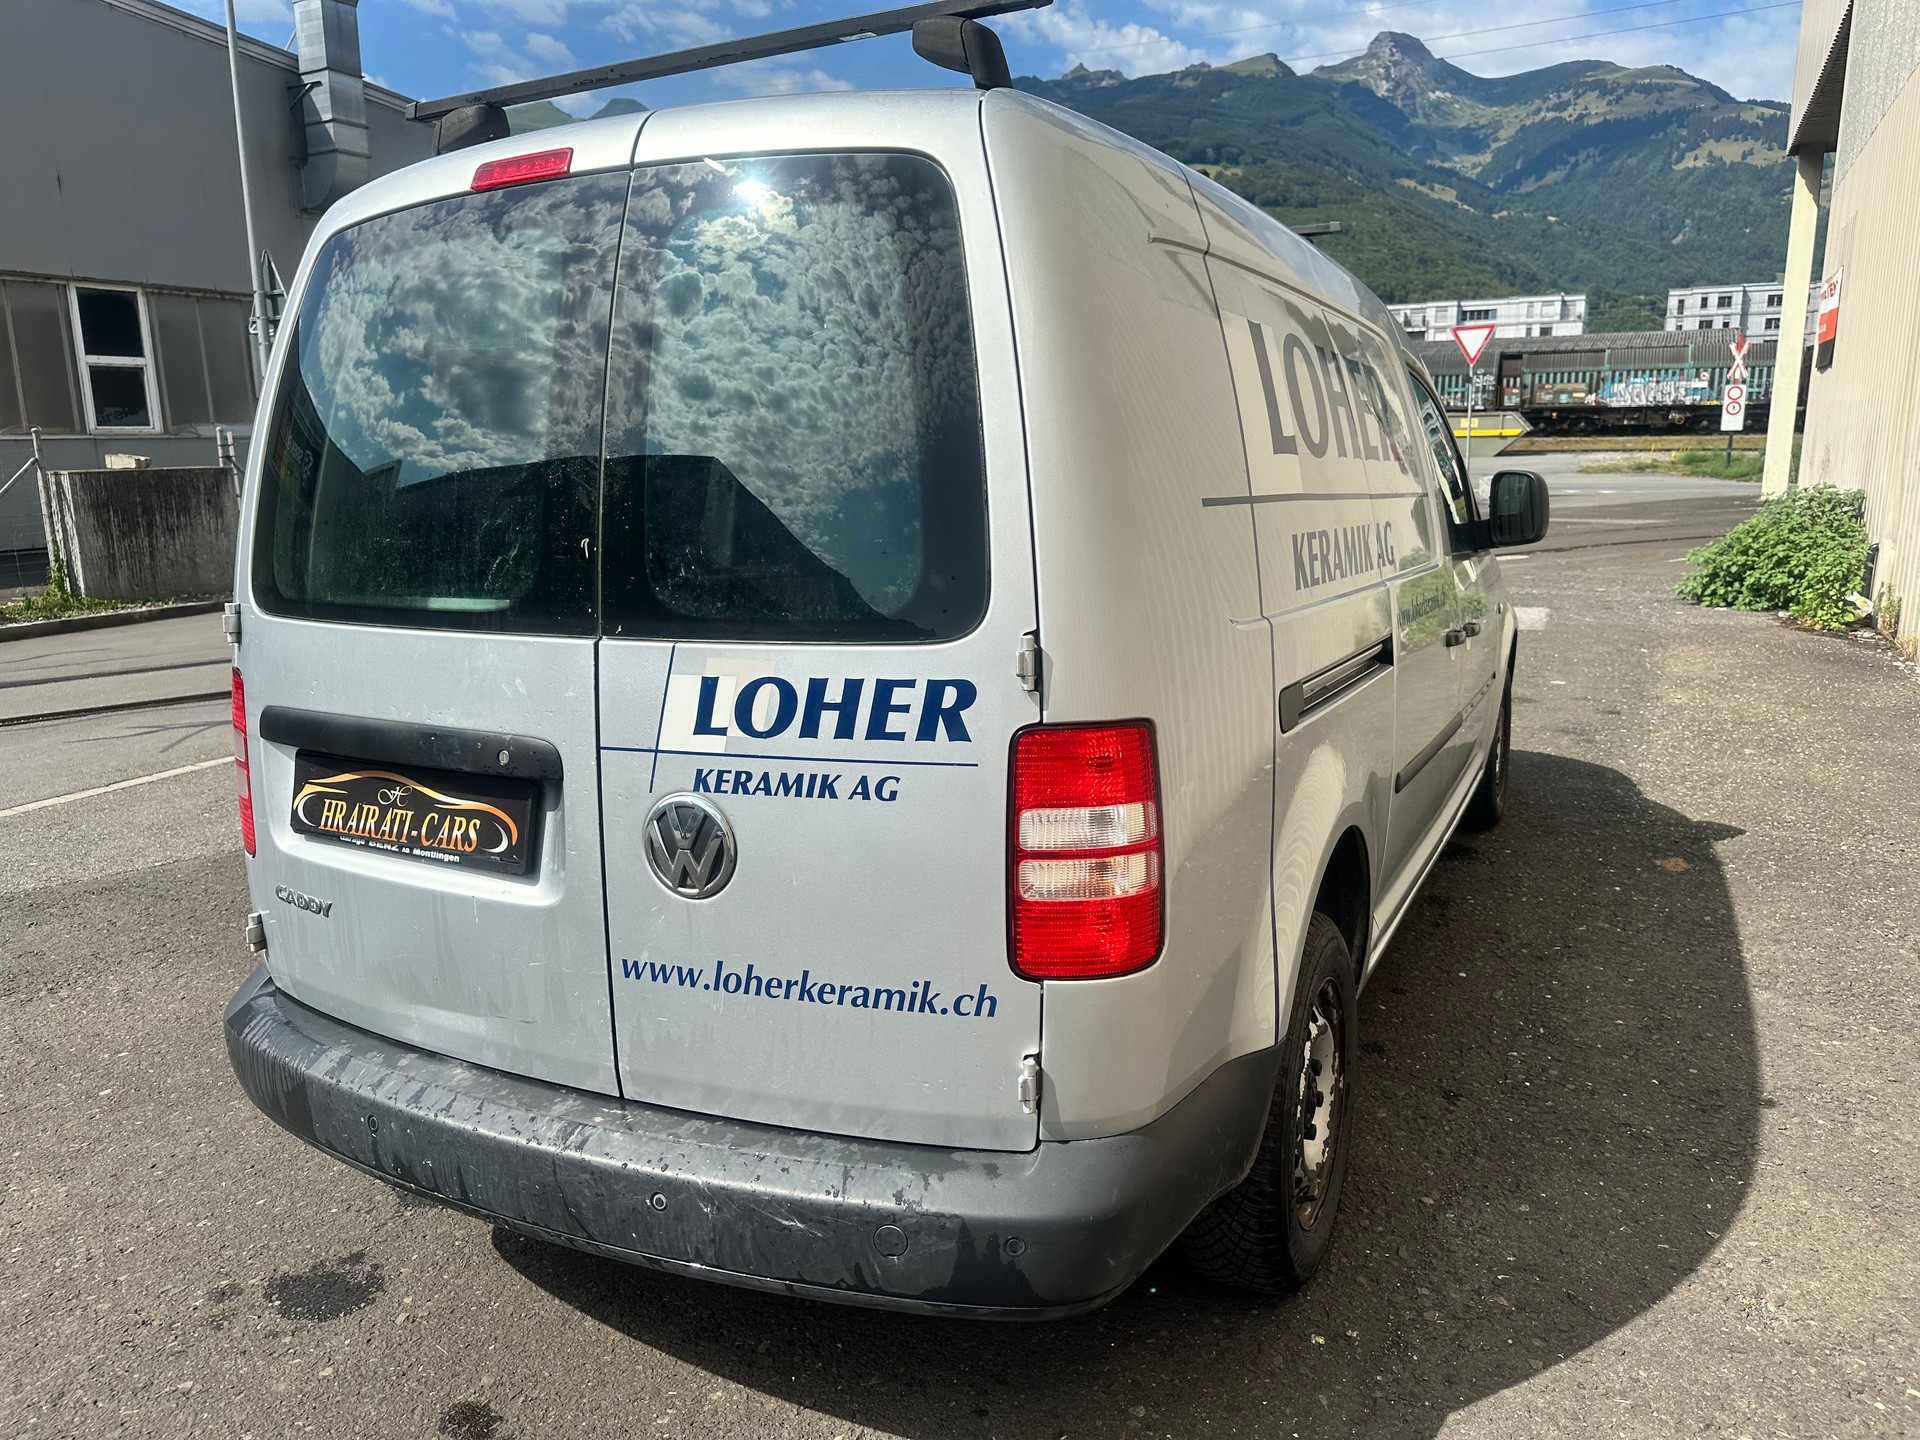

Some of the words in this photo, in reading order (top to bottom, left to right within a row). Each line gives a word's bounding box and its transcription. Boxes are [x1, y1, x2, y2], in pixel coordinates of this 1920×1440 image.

[1292, 524, 1374, 591] KERAMIK
[1376, 521, 1395, 569] AG
[692, 675, 978, 743] LOHER
[692, 768, 843, 800] KERAMIK
[847, 775, 901, 802] AG
[318, 798, 481, 853] HRAIRATI-CARS
[275, 884, 333, 919] CADDY
[621, 957, 999, 1018] www.loherkeramik.ch
